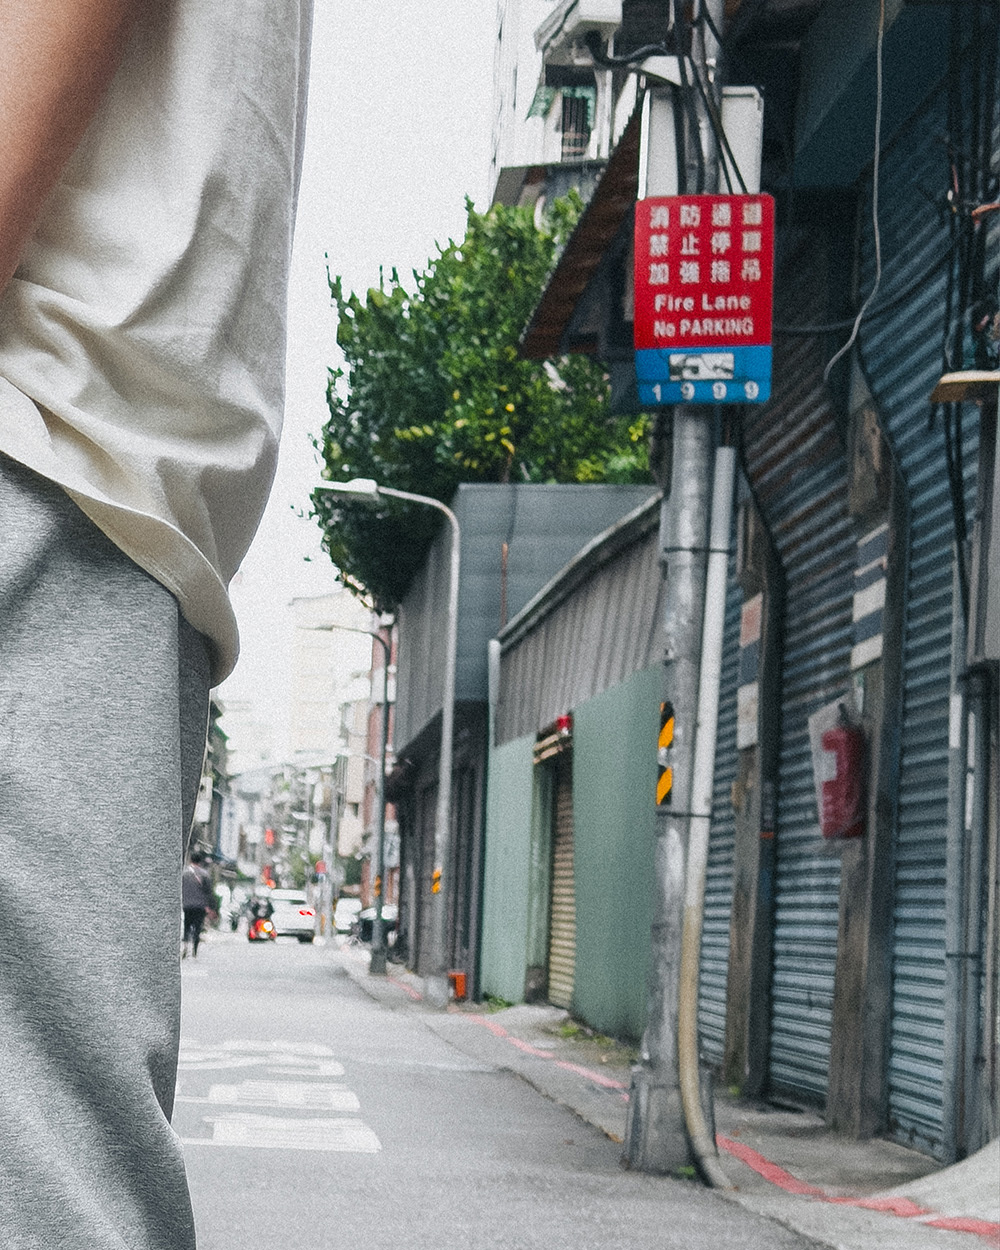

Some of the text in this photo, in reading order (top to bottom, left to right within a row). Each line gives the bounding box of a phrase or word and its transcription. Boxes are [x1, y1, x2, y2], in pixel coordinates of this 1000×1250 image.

[650, 203, 762, 229] 消防通道
[650, 231, 762, 257] 禁止停車
[648, 259, 761, 285] 加強拖吊
[654, 293, 752, 312] Fire Lane
[653, 317, 754, 337] No PARKING
[652, 381, 760, 401] 1999
